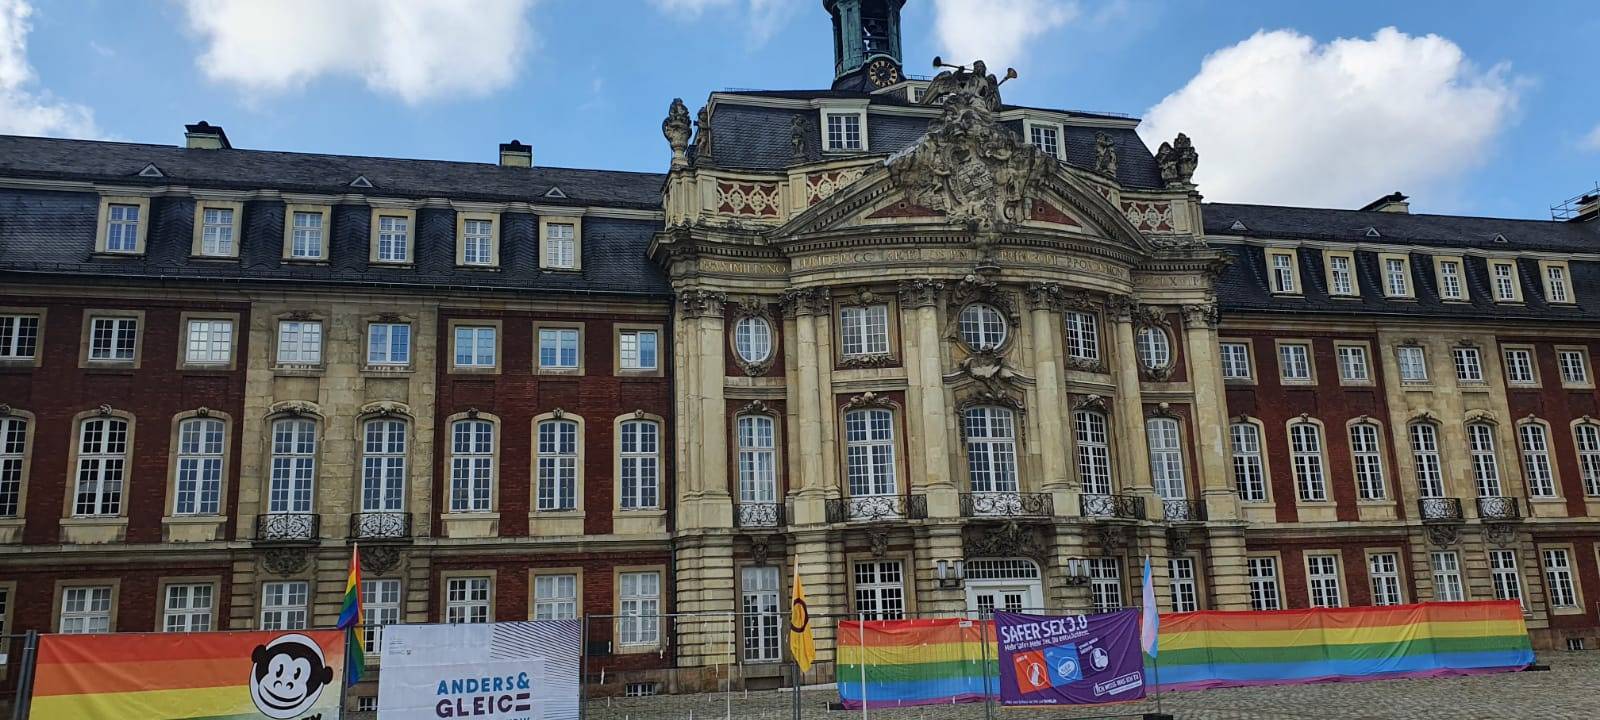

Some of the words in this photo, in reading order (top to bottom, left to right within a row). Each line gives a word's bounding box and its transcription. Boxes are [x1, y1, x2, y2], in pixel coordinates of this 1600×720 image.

[1001, 623, 1041, 643] SAFER
[1042, 619, 1066, 636] SEX
[1067, 614, 1087, 632] 3.0
[437, 671, 530, 695] ANDERS&
